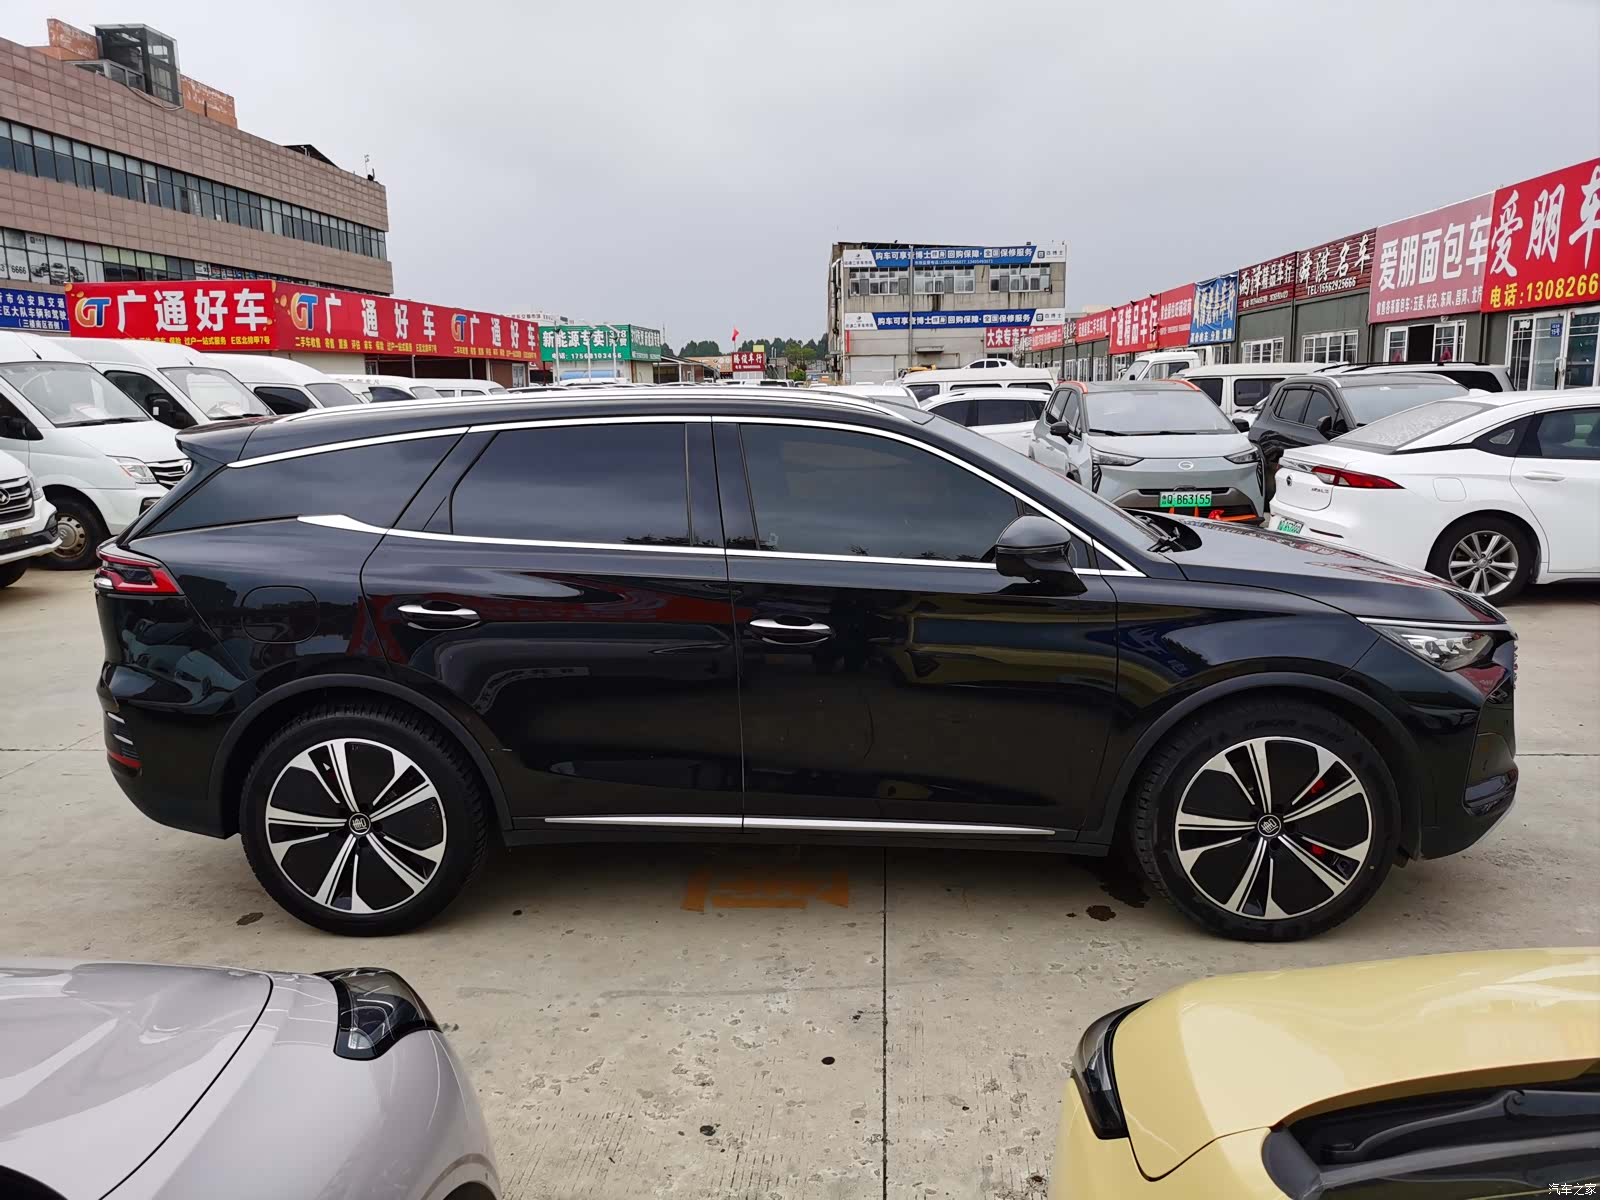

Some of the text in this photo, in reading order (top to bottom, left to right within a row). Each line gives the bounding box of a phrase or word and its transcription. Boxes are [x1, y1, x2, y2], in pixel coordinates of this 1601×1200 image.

[1378, 214, 1491, 292] 爱朋面包车
[75, 288, 268, 333] GT 广通好车
[325, 293, 436, 342] 广通好车
[470, 314, 536, 351] 广通好车
[542, 329, 605, 348] 新能源专卖
